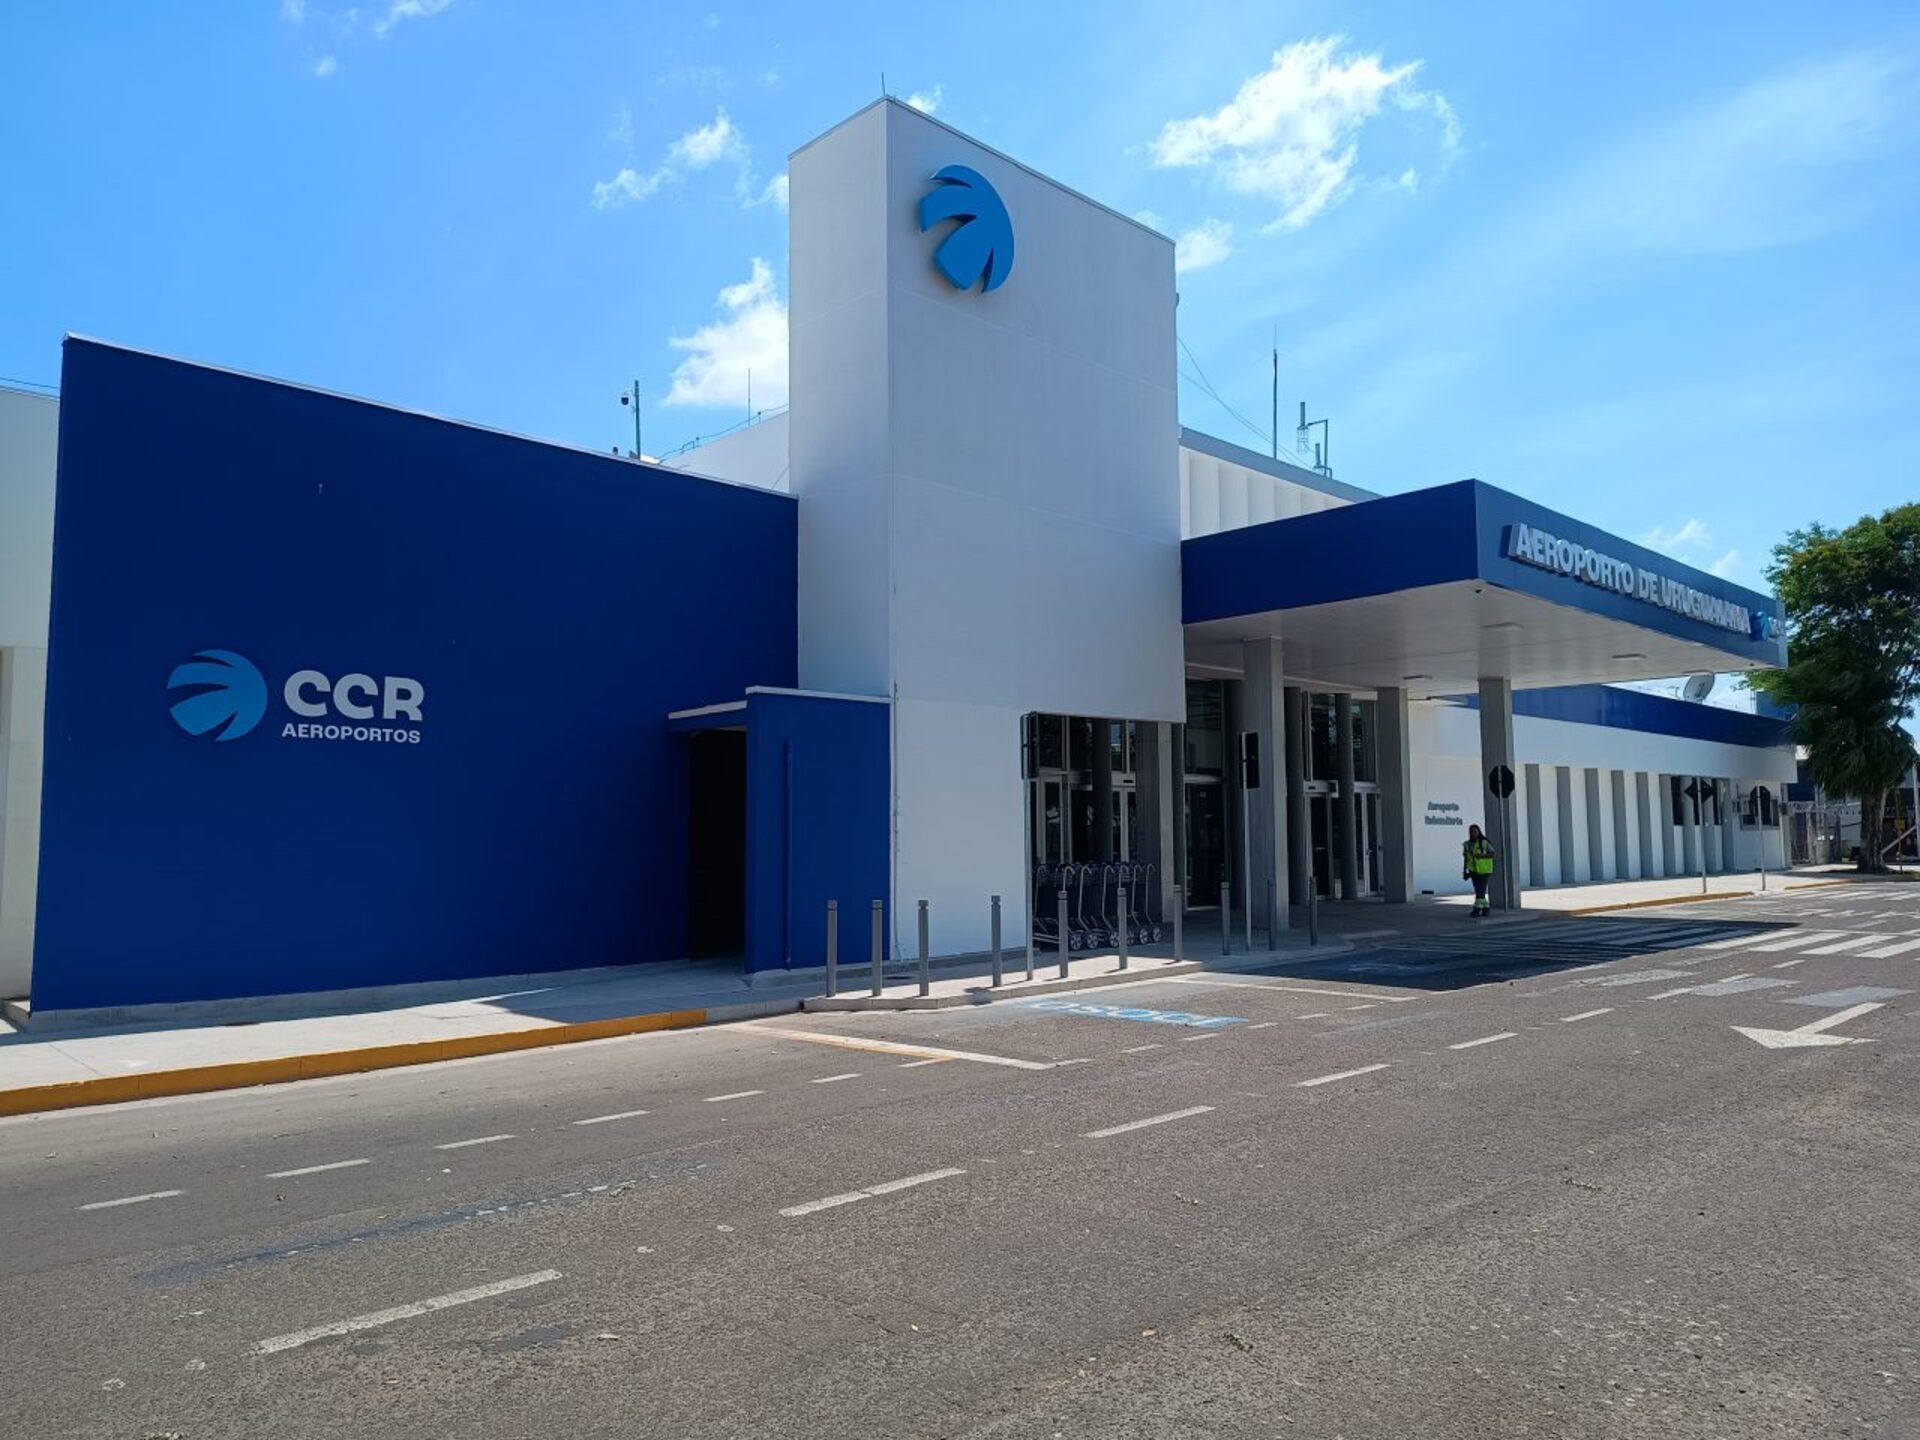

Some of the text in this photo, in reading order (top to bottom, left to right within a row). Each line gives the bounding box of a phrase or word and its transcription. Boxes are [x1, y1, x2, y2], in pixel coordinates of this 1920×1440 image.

[1509, 523, 1634, 595] AEROPORTO
[1636, 567, 1659, 602] DE
[284, 669, 425, 721] CCR
[281, 723, 421, 744] AEROPORTOS
